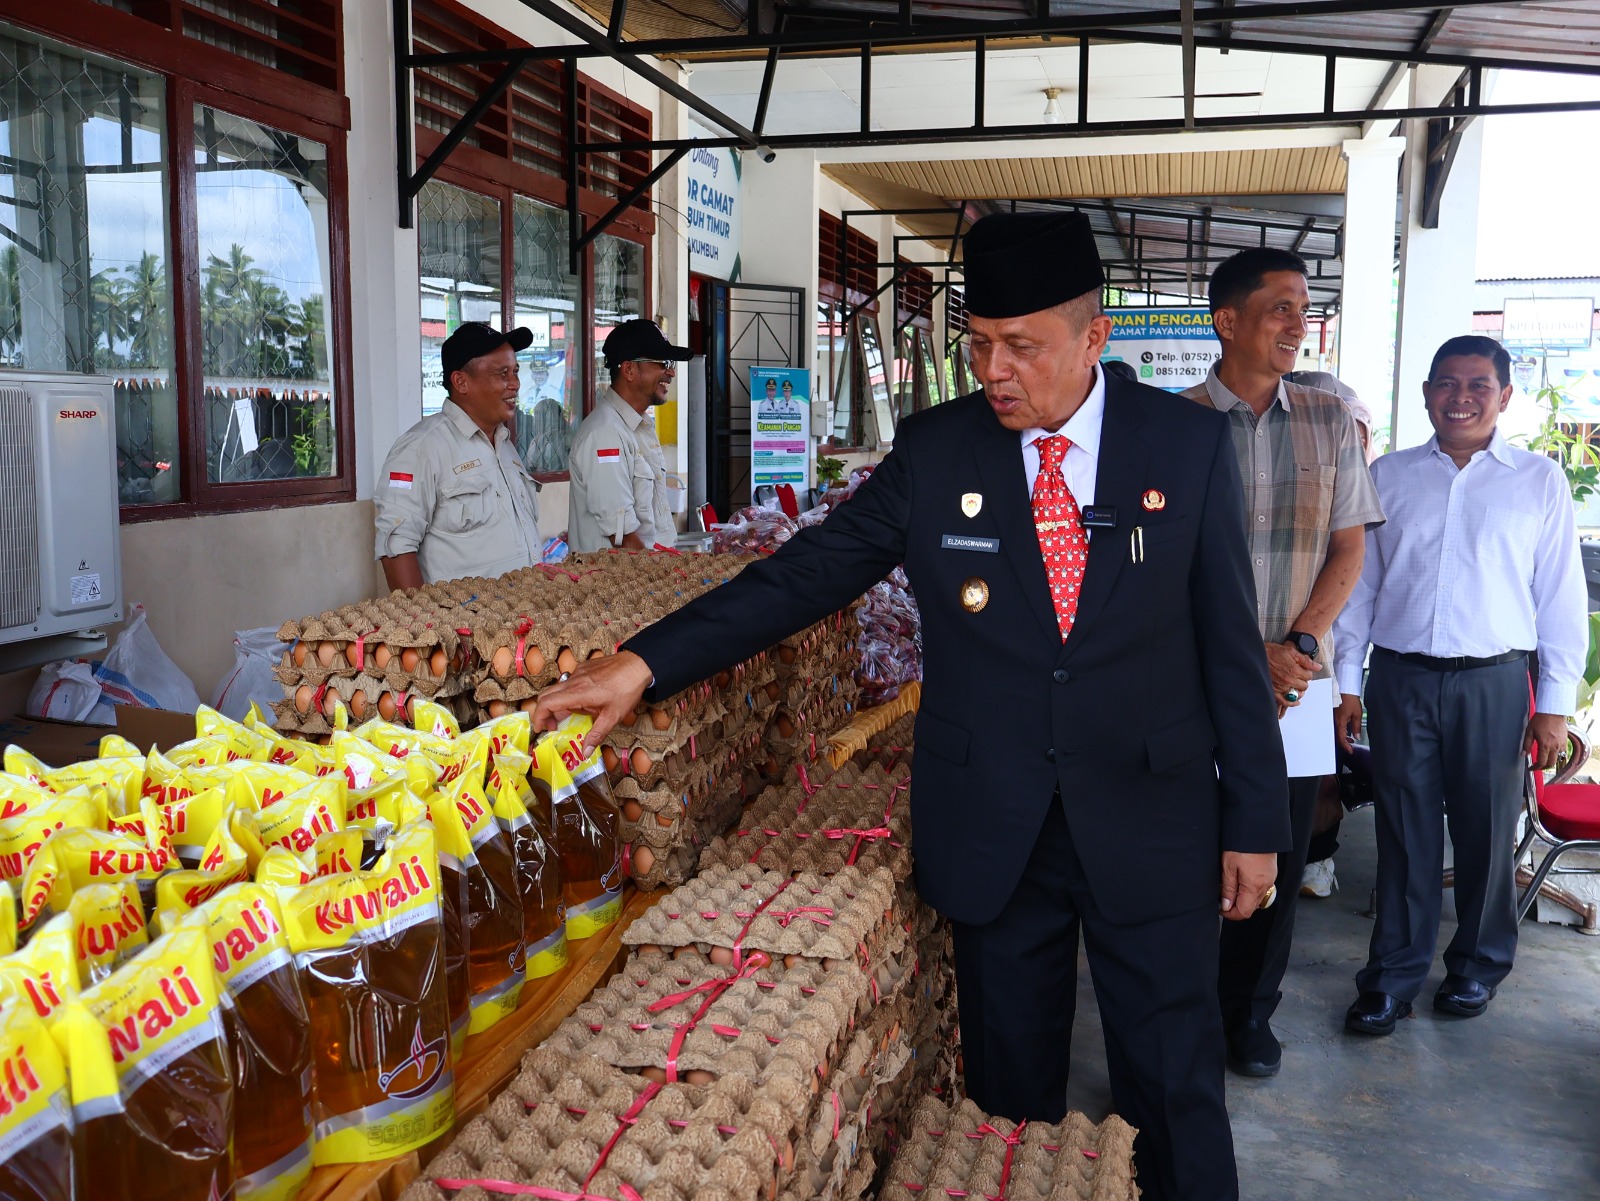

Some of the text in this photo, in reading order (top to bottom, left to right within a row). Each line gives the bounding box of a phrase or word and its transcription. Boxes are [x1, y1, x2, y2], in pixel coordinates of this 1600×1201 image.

[701, 184, 734, 217] CAMAT
[688, 206, 731, 239] BUH TIMUR
[1112, 314, 1213, 326] NAN PENGAD
[1112, 327, 1147, 336] CAMAT
[1156, 352, 1179, 363] Telp.
[1181, 352, 1212, 363] (0752)
[1156, 367, 1208, 376] 085126211
[60, 410, 97, 419] SHARP
[315, 852, 432, 936] Kuwali
[213, 898, 281, 974] wali
[107, 965, 202, 1064] wali
